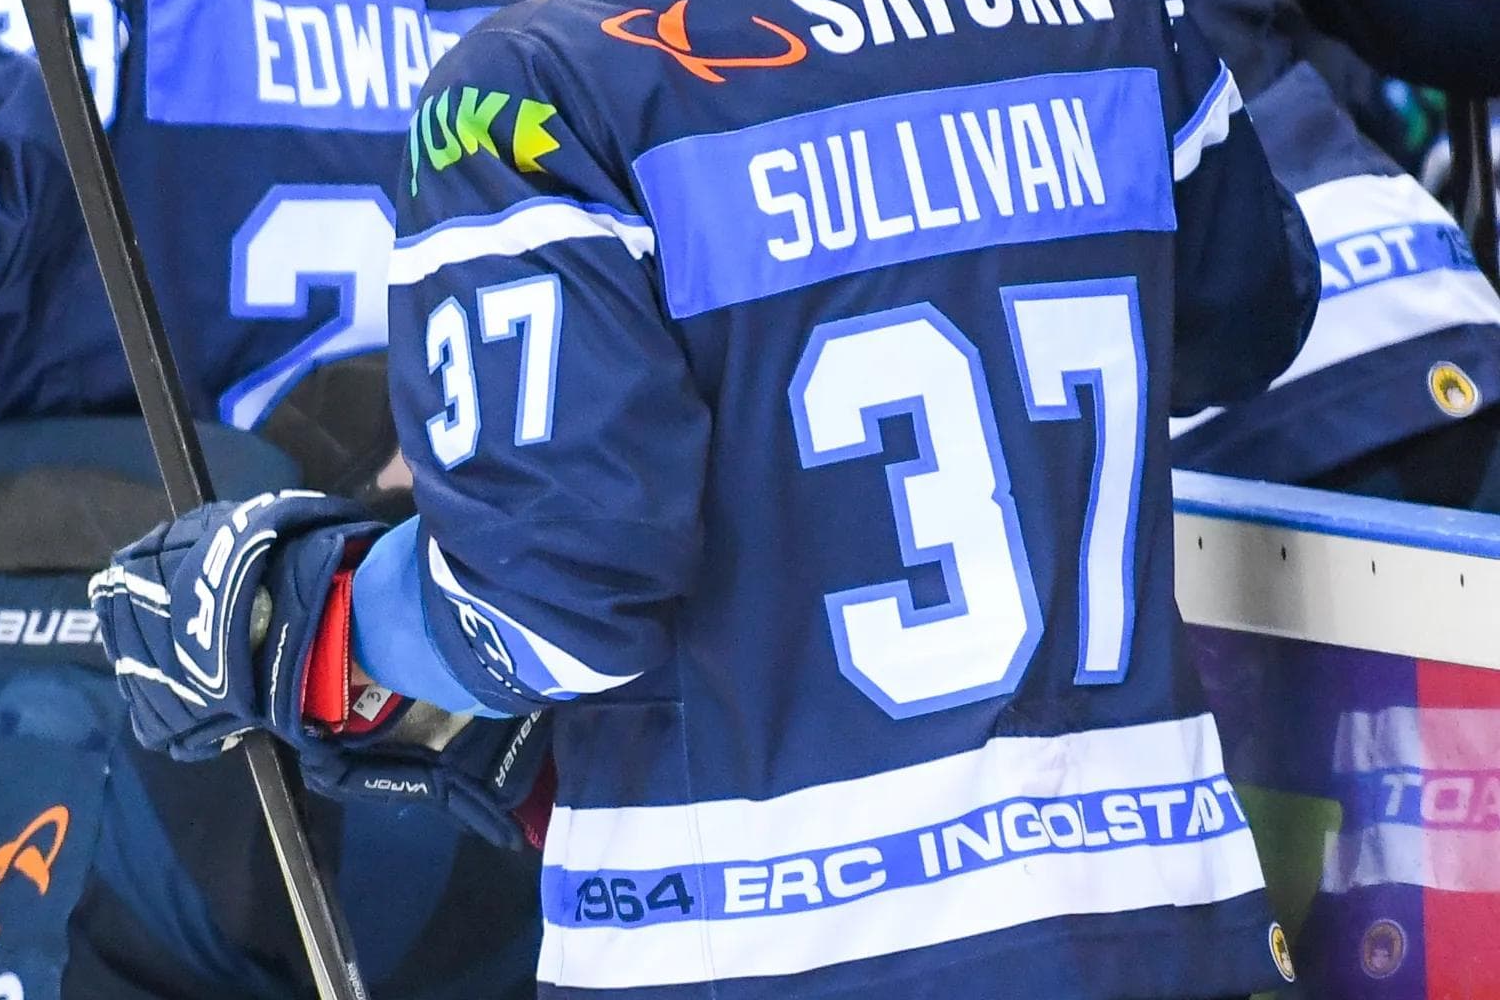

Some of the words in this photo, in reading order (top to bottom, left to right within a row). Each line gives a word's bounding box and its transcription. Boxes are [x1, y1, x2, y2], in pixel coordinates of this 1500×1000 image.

[749, 97, 1106, 262] SULLIVAN
[425, 272, 563, 471] 37
[788, 274, 1148, 720] 37
[575, 872, 695, 923] 1964
[724, 846, 888, 914] ERC
